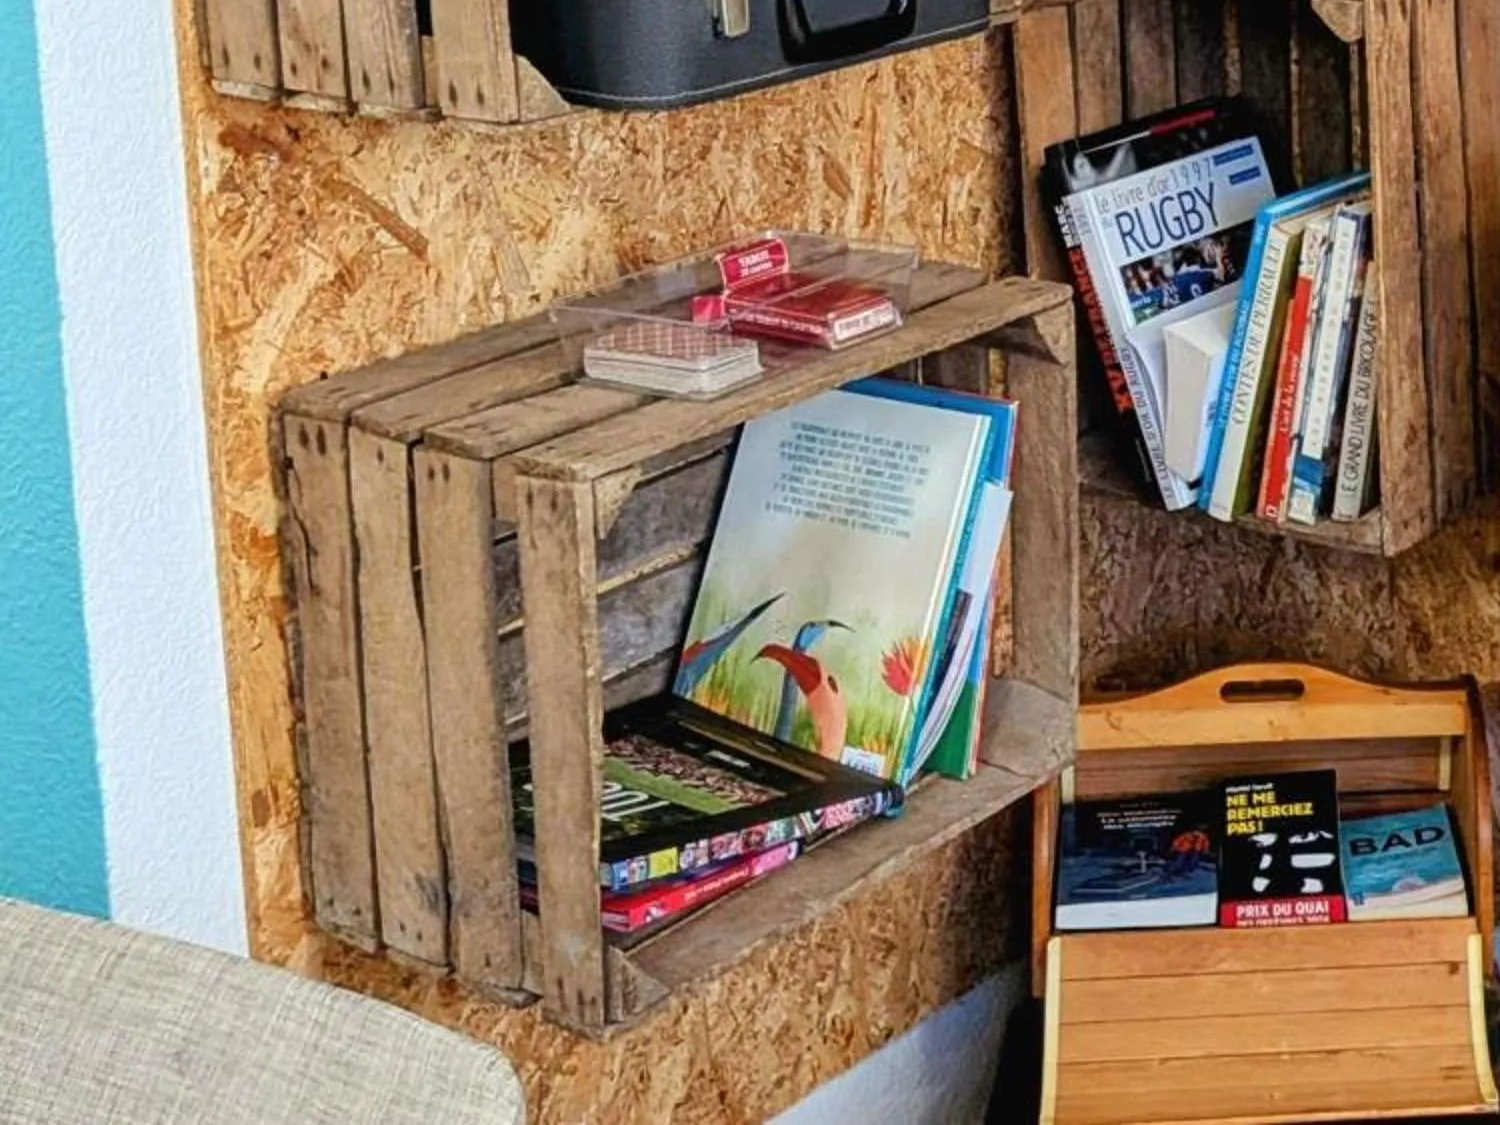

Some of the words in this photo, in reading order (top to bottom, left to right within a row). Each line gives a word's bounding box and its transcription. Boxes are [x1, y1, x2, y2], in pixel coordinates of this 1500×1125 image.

[1109, 178, 1146, 210] livre
[1168, 156, 1214, 189] 1997
[1117, 183, 1220, 256] RUGBY
[1357, 310, 1378, 378] BRICOLAGE
[1354, 378, 1370, 399] DU
[1349, 401, 1367, 436] LIVRE
[1343, 434, 1363, 481] GRAND
[1227, 794, 1248, 807] NE
[1252, 791, 1276, 804] ME
[1227, 802, 1314, 820] REMERCIEZ
[1349, 826, 1445, 856] BAD
[1236, 905, 1271, 918] PRIX
[1273, 903, 1292, 916] DU
[1295, 901, 1330, 915] QUAI
